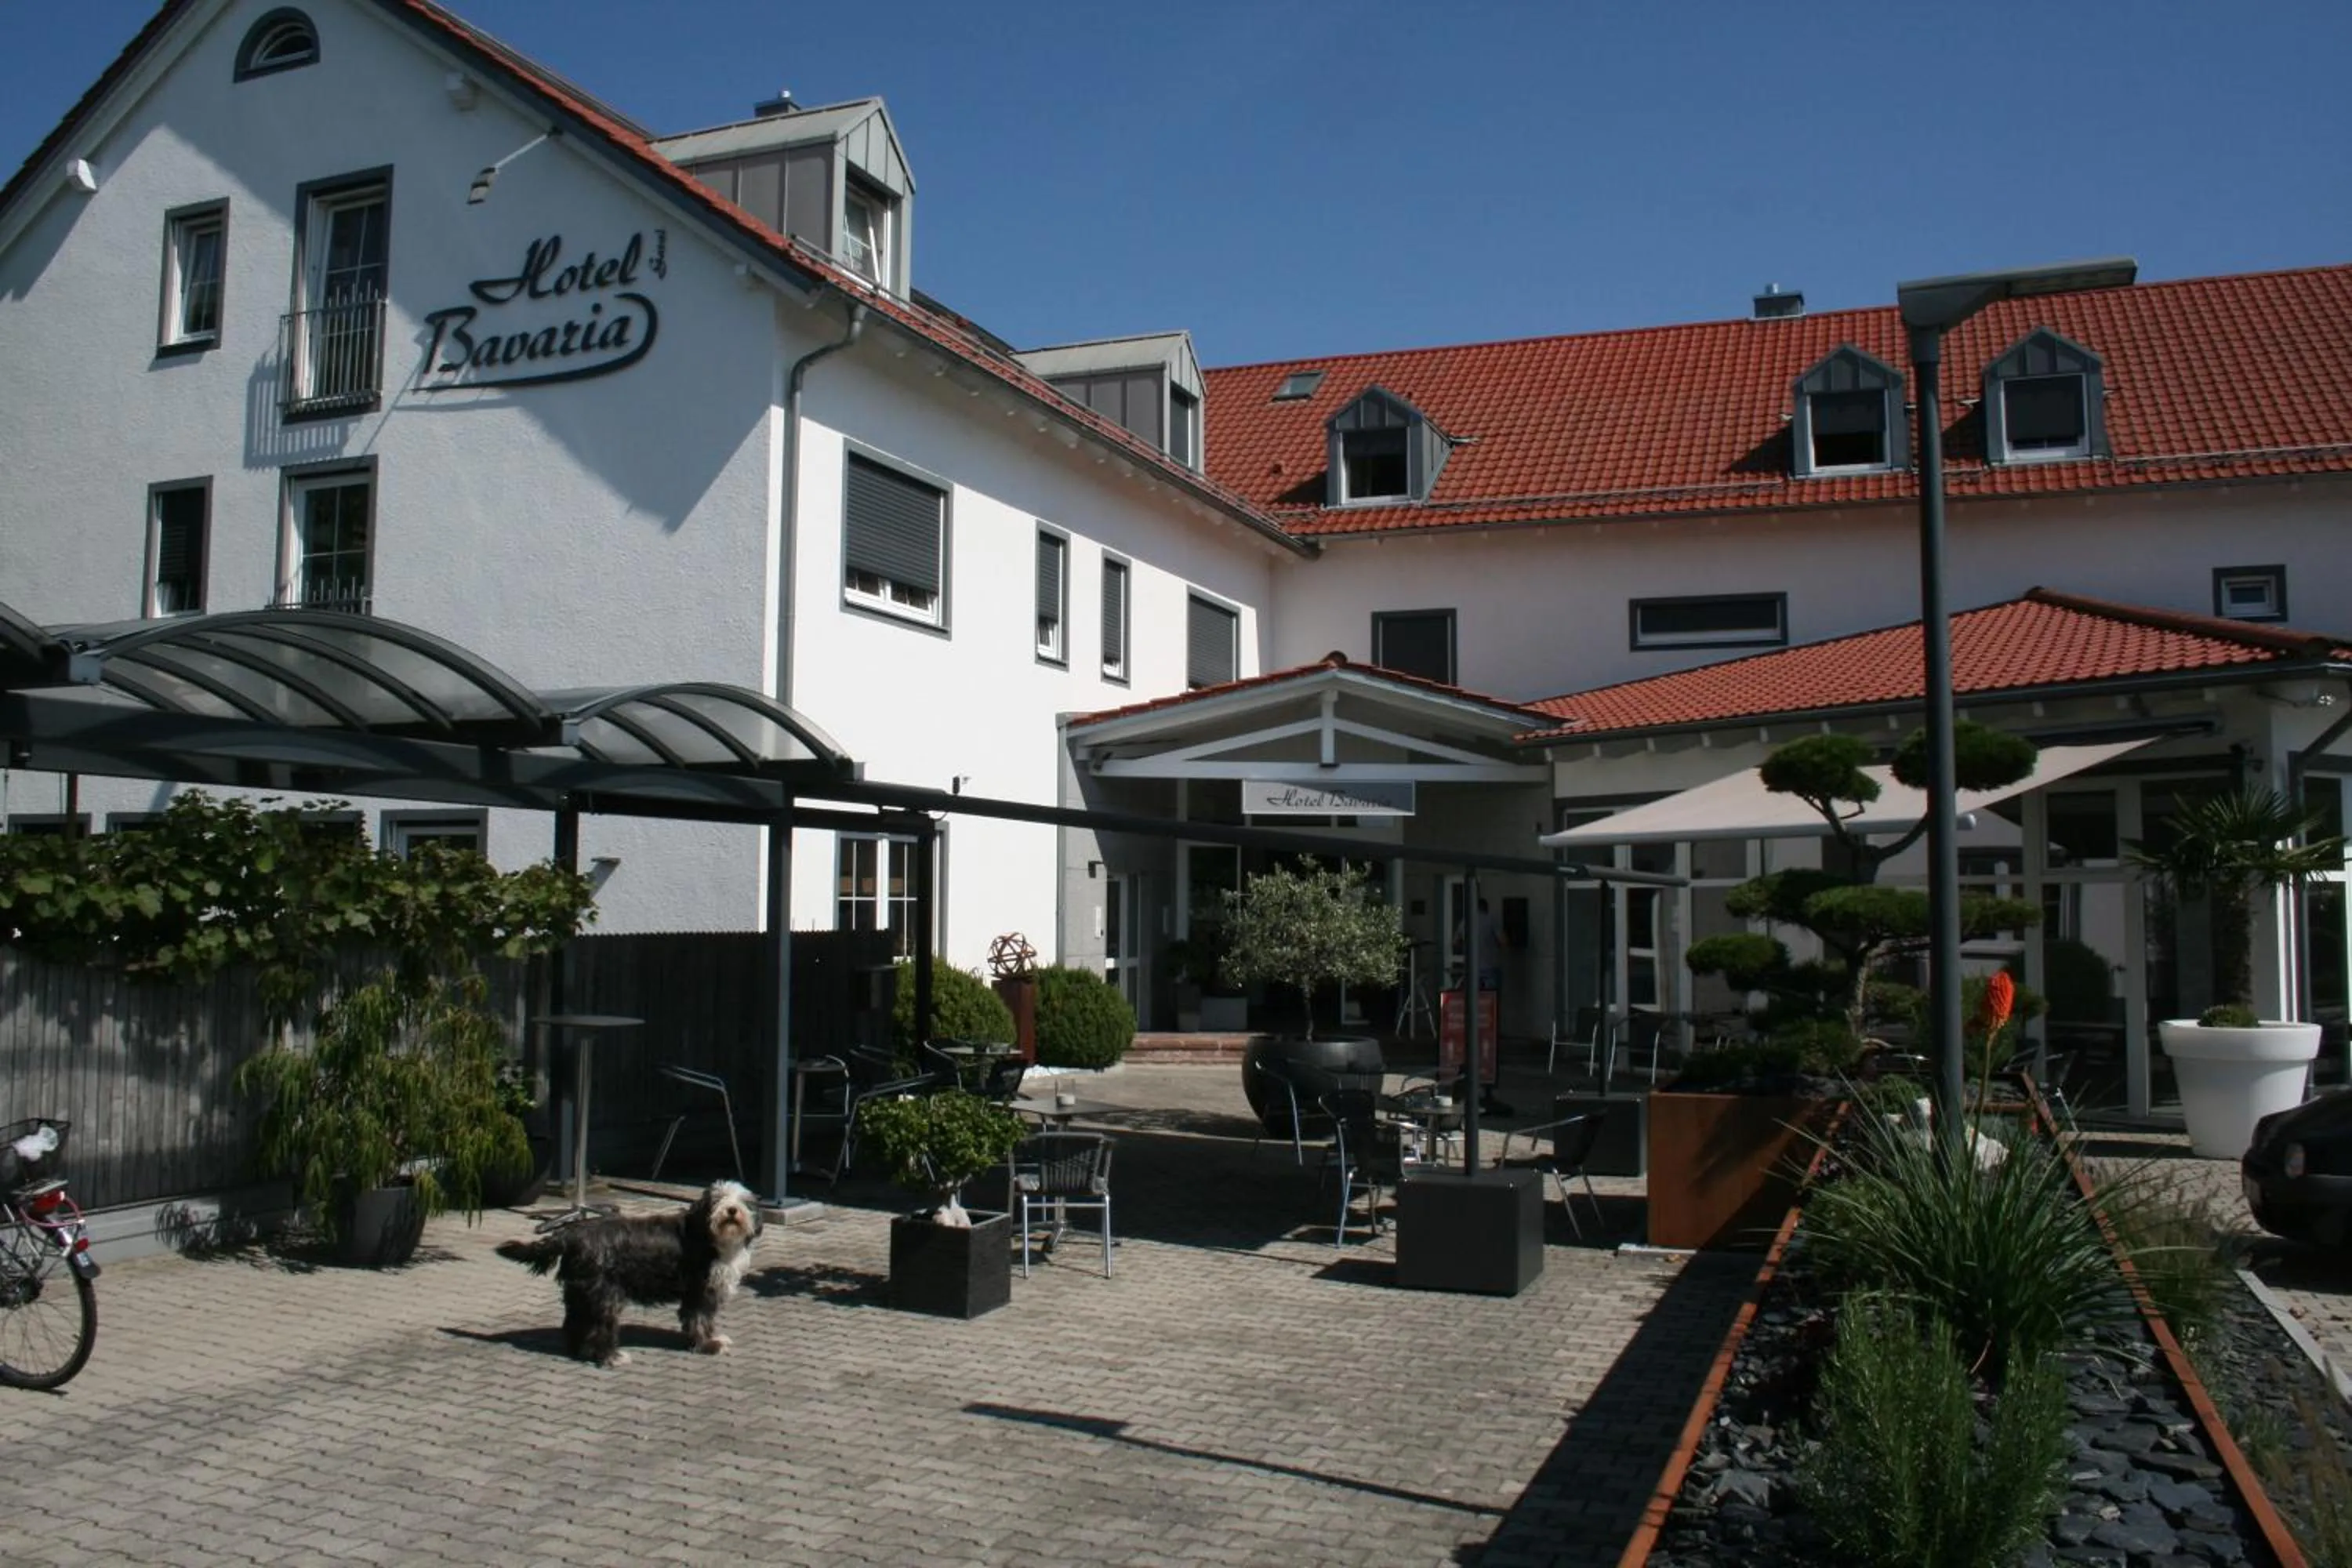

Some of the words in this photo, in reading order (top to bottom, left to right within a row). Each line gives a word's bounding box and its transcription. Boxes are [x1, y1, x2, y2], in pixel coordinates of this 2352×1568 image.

[469, 233, 643, 304] Hotel
[422, 303, 633, 376] Bavaria
[1266, 789, 1325, 808] Hotel
